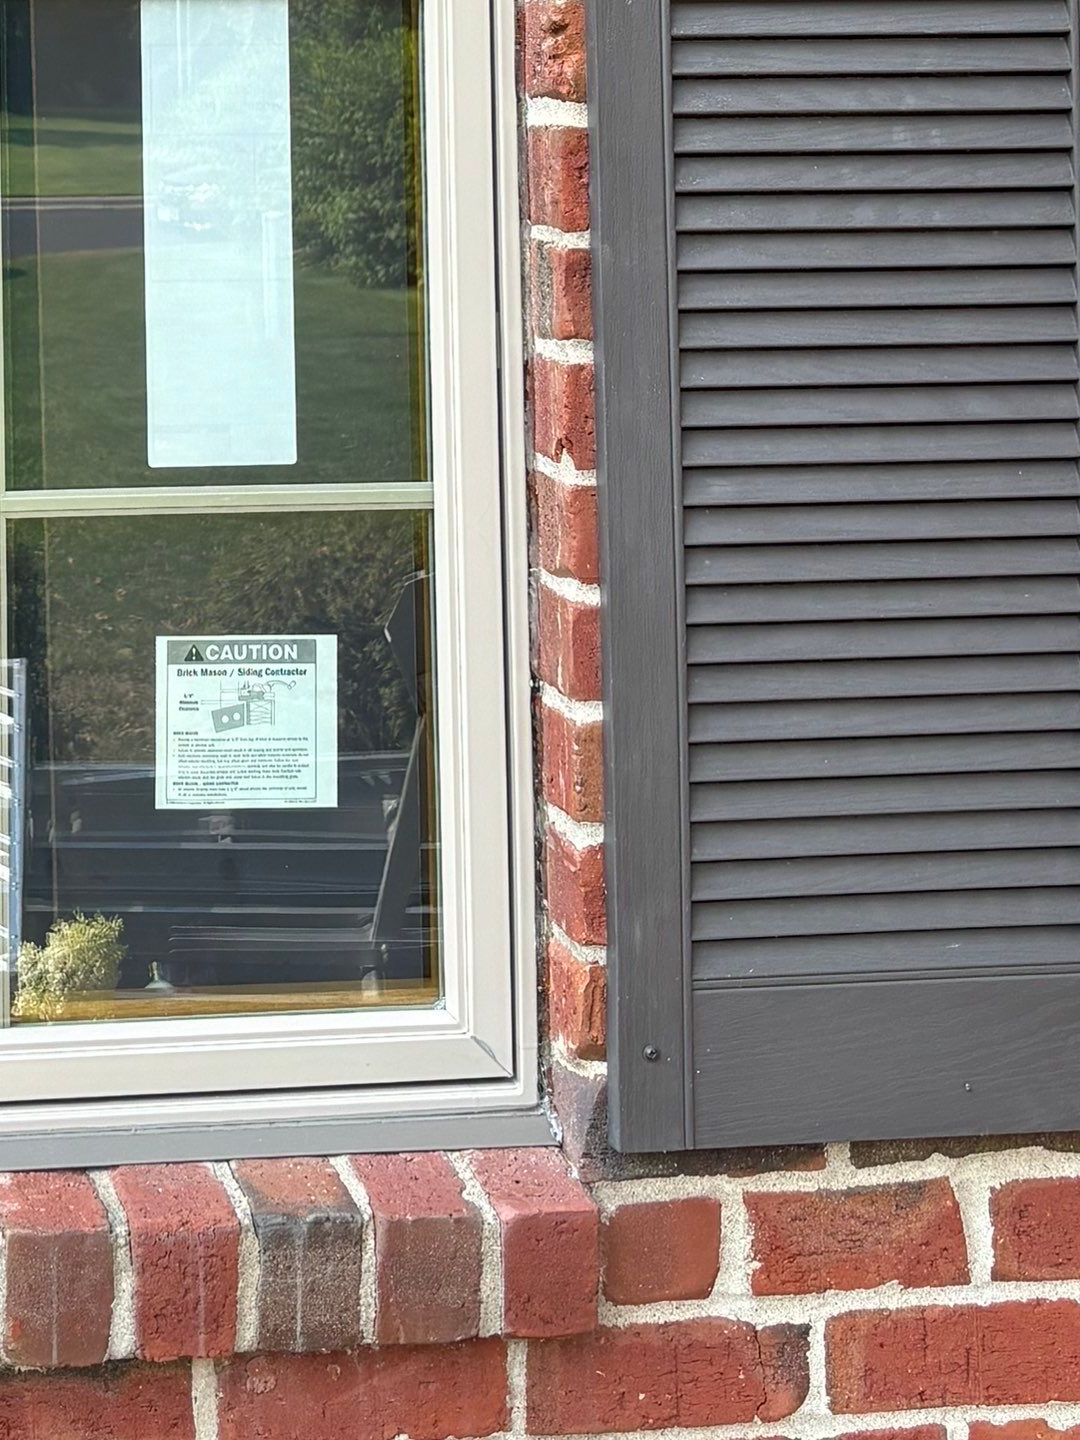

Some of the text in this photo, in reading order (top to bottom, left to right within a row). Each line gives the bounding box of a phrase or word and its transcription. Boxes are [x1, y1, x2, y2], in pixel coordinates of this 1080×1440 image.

[205, 644, 298, 661] CAUTION
[177, 669, 199, 677] Brick
[200, 669, 227, 677] Mason
[237, 668, 263, 677] Siding
[265, 668, 307, 676] Contractor
